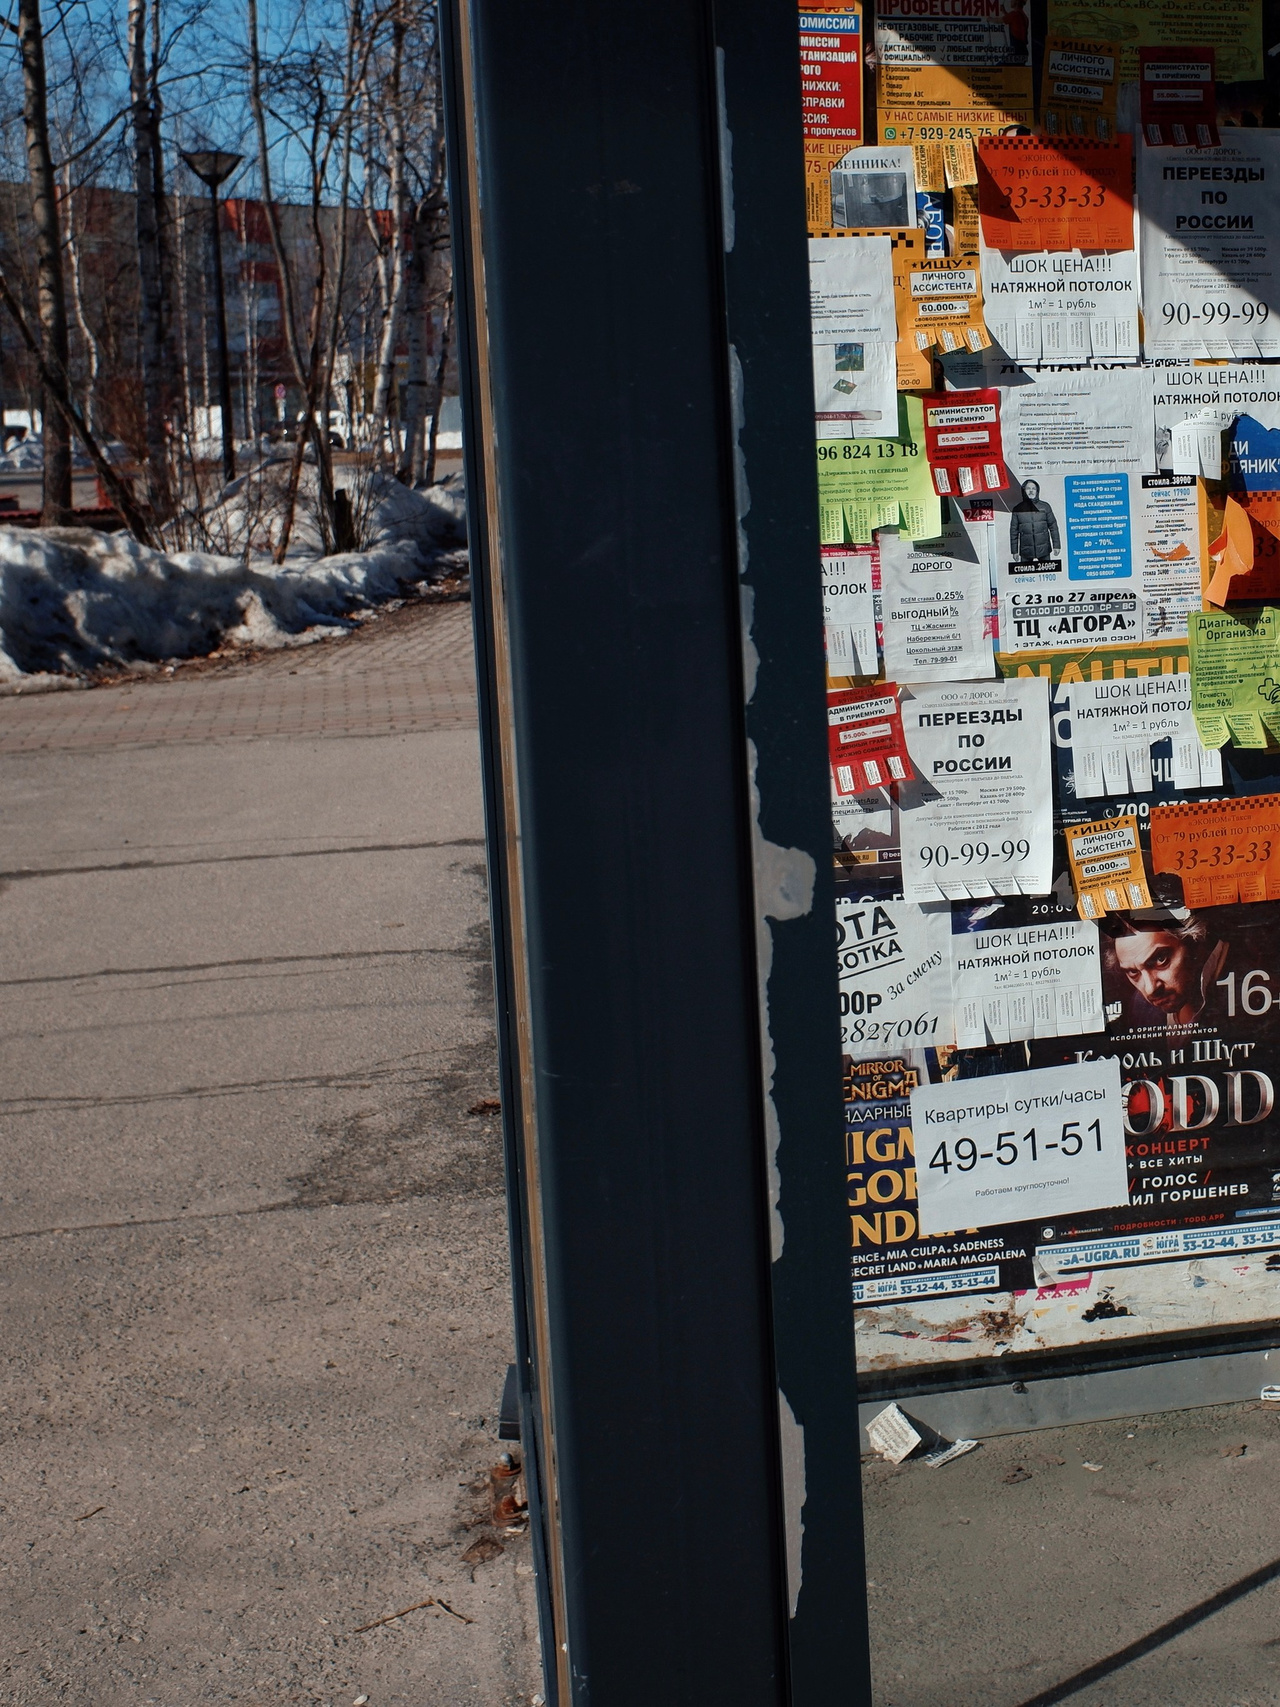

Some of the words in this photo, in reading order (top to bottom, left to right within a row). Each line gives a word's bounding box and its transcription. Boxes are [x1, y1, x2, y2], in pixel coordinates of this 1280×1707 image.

[894, 112, 914, 121] НАС
[916, 112, 953, 121] САМЫЕ
[1002, 166, 1015, 176] 79
[1018, 166, 1059, 179] рублей
[1163, 166, 1265, 183] ПЕРЕЕЗДЫ
[1201, 191, 1228, 205] ПО
[1175, 215, 1254, 230] РОССИИ
[920, 259, 963, 270] ИЩУ
[1010, 259, 1047, 273] ШОК
[1053, 258, 1112, 275] ЦЕНА!!!
[921, 271, 966, 281] ЛИЧНОГО
[912, 282, 974, 293] АССИСТЕНТА
[991, 279, 1065, 293] НАТЯЖНОЙ
[1069, 280, 1133, 292] ПОТОЛОК
[1066, 299, 1096, 310] рубль
[1162, 302, 1269, 325] 90-99-99
[1167, 372, 1203, 386] ШОК
[1208, 369, 1266, 387] ЦЕНА!!!
[928, 406, 995, 417] АДМИНИСТРАТОР
[843, 444, 871, 459] 824
[877, 444, 895, 458] 13
[901, 443, 918, 456] 18
[912, 561, 953, 573] ДОРОГО
[1025, 592, 1043, 605] 23
[1047, 595, 1064, 603] по
[1068, 591, 1085, 602] 27
[1090, 592, 1137, 602] апреля
[891, 606, 949, 620] ВЫГОДНЫЙ
[1025, 607, 1050, 616] 10.00
[1053, 606, 1066, 615] ДО
[1069, 605, 1094, 613] 20.00
[1014, 620, 1041, 638] ТЦ
[1048, 614, 1136, 634] «АГОРА»
[1199, 615, 1272, 630] Диагностика
[1057, 636, 1107, 645] НАПРОТИВ
[1110, 634, 1136, 642] ОЗОН
[1206, 627, 1266, 642] Организма
[1095, 683, 1131, 700] ШОК
[828, 697, 893, 716] АДМИНИСТРАТОР
[1077, 701, 1149, 719] НАТЯЖНОЙ
[1216, 697, 1232, 707] 96%
[919, 708, 1023, 727] ПЕРЕЕЗДЫ
[1149, 719, 1179, 733] рубль
[958, 734, 985, 748] ПО
[933, 756, 1012, 773] РОССИИ
[1081, 820, 1121, 835] ИЩУ
[1173, 831, 1186, 842] 79
[1189, 828, 1227, 844] рублей
[1230, 826, 1244, 836] по
[1082, 830, 1125, 846] ЛИЧНОГО
[920, 839, 1030, 869] 90-99-99
[1075, 839, 1133, 857] АССИСТЕНТА
[1174, 840, 1273, 871] 33-33-33
[975, 933, 1012, 950] ШОК
[1017, 925, 1075, 947] ЦЕНА!!!
[958, 950, 1030, 970] НАТЯЖНОЙ
[1034, 945, 1095, 961] ПОТОЛОК
[887, 983, 905, 1001] За
[906, 950, 943, 986] смену
[1031, 966, 1061, 980] рубль
[1110, 1032, 1163, 1042] ИСПОЛНЕНИИ
[1166, 1027, 1218, 1036] МУЗЫКАНТОВ
[1136, 1022, 1200, 1033] ОРИГИНАЛЬНОМ
[1170, 1048, 1184, 1065] и
[1192, 1038, 1256, 1067] Шут
[850, 1059, 905, 1077] MIRROR
[925, 1102, 1009, 1125] Квартиры
[1014, 1087, 1106, 1113] сутки/часы
[928, 1118, 1103, 1175] 49-51-51
[1126, 1137, 1210, 1156] КОНЦЕРТ
[1140, 1158, 1164, 1169] ВСЕ
[1168, 1154, 1203, 1167] ХИТЫ
[975, 1185, 1013, 1197] Работаем
[1014, 1177, 1070, 1193] круглосуточно!
[1142, 1173, 1198, 1189] ГОЛОС
[1160, 1183, 1249, 1203] ГОРШЕНЕВ
[886, 1249, 908, 1260] MIA
[911, 1245, 945, 1258] CULPA
[953, 1238, 1004, 1253] SADENESS
[888, 1260, 917, 1273] LAND
[923, 1256, 958, 1269] MARIA
[960, 1248, 1027, 1265] MAGDALENA
[952, 1275, 996, 1289] 33-13-44
